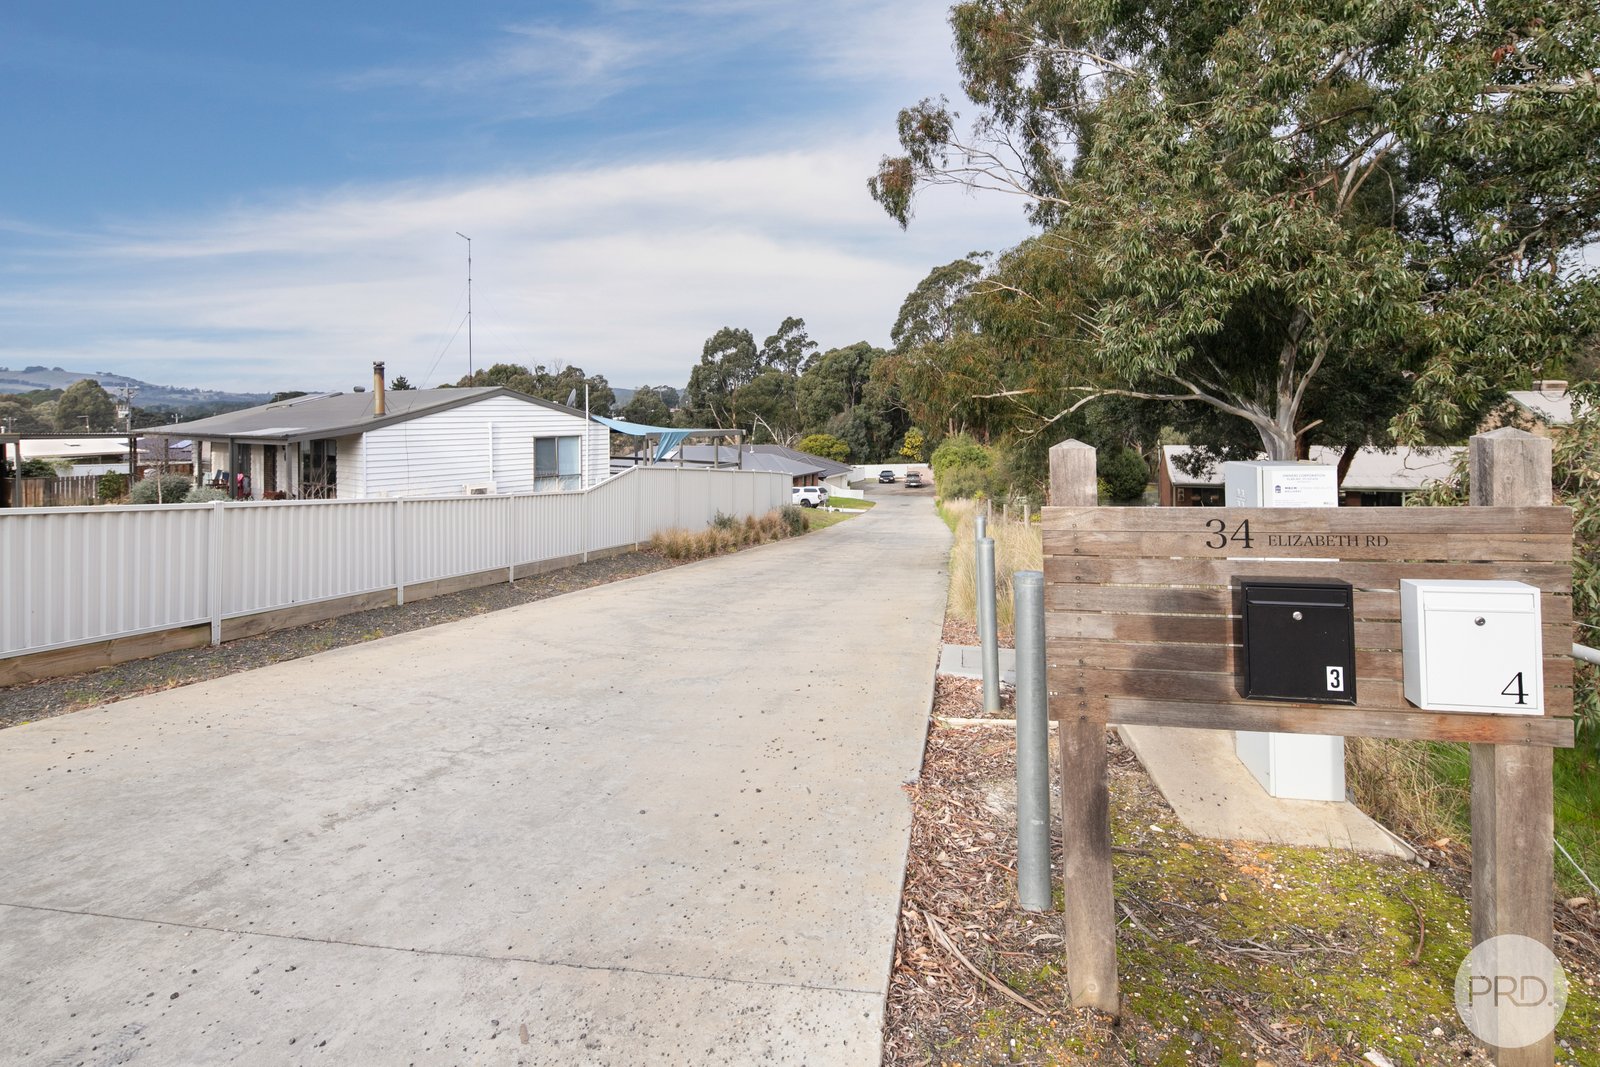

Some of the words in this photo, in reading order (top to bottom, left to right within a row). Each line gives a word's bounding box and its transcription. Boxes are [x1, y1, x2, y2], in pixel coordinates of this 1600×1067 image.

[1205, 519, 1254, 549] 34
[1268, 535, 1359, 547] ELIZABETH
[1365, 535, 1389, 547] RD
[1330, 669, 1341, 689] 3
[1501, 671, 1529, 705] 4
